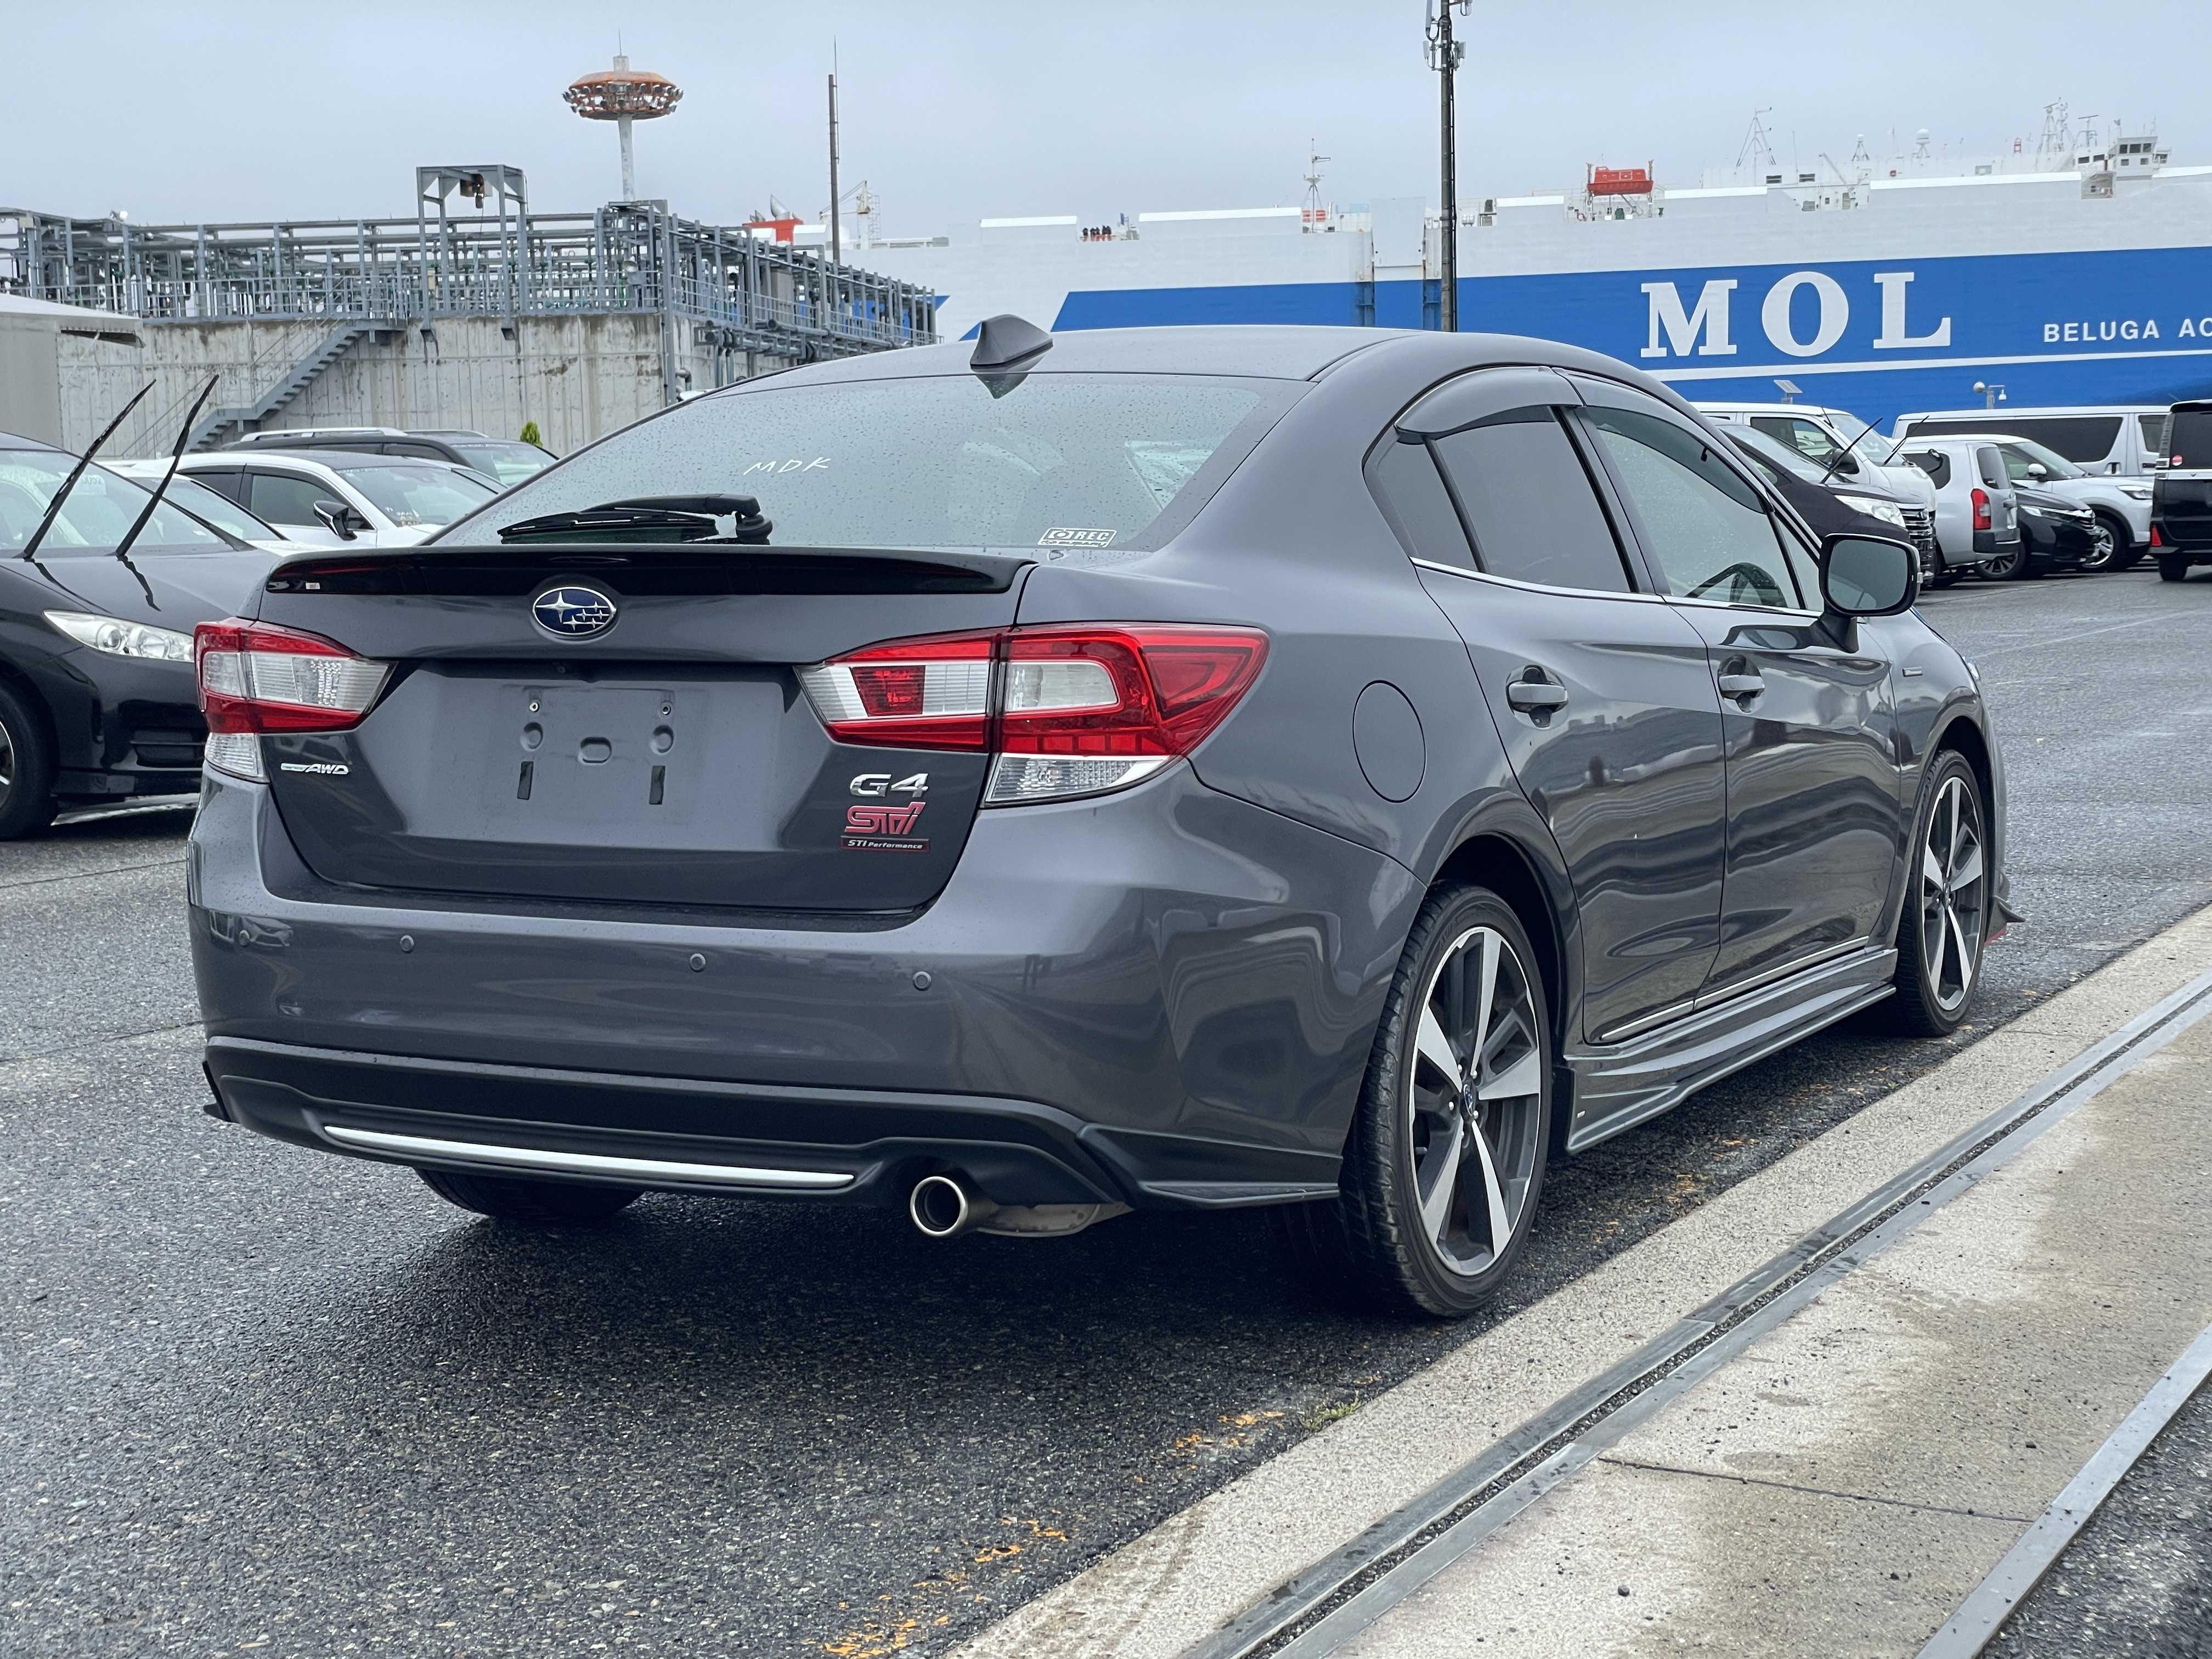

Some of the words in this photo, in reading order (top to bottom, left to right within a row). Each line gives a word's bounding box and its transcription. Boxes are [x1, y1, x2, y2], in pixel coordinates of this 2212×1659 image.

[1641, 271, 1951, 357] MOL
[2044, 320, 2160, 342] BELUGA
[1074, 531, 1110, 540] REC
[305, 764, 349, 775] AWD
[850, 773, 929, 798] G4
